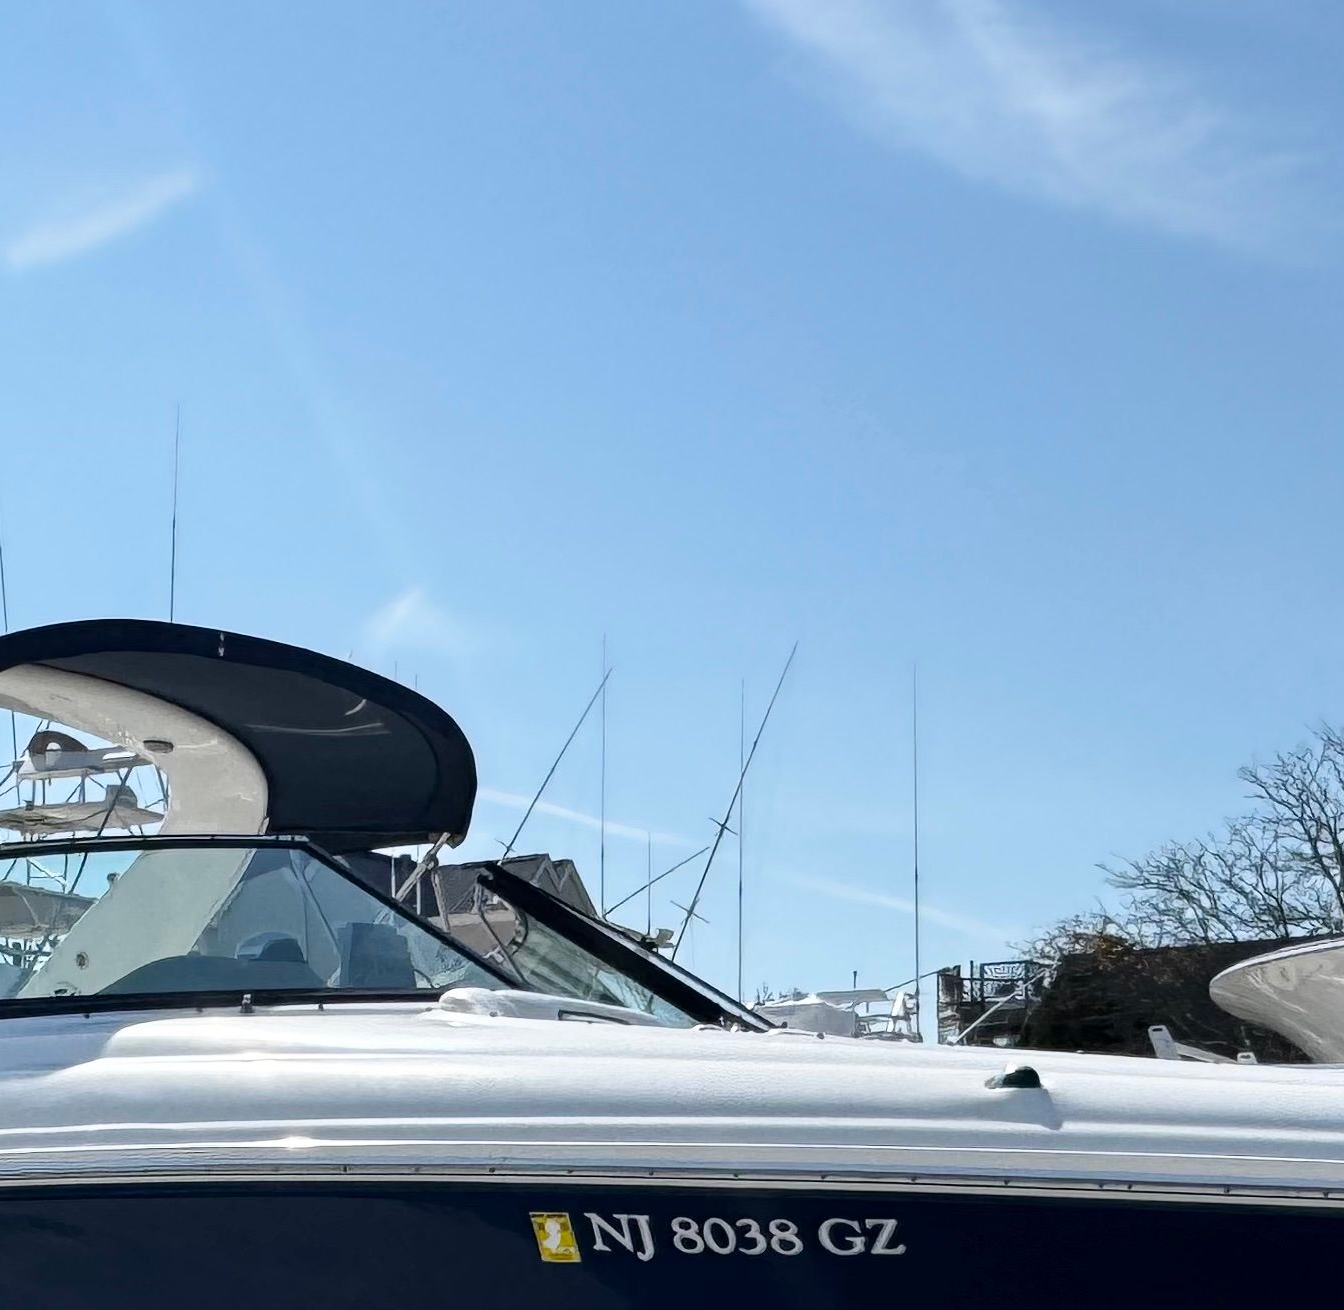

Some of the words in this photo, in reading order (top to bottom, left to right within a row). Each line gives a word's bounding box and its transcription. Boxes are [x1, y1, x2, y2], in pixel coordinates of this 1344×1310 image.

[583, 1211, 656, 1262] NJ
[670, 1216, 805, 1256] 8038
[818, 1217, 907, 1256] GZ
